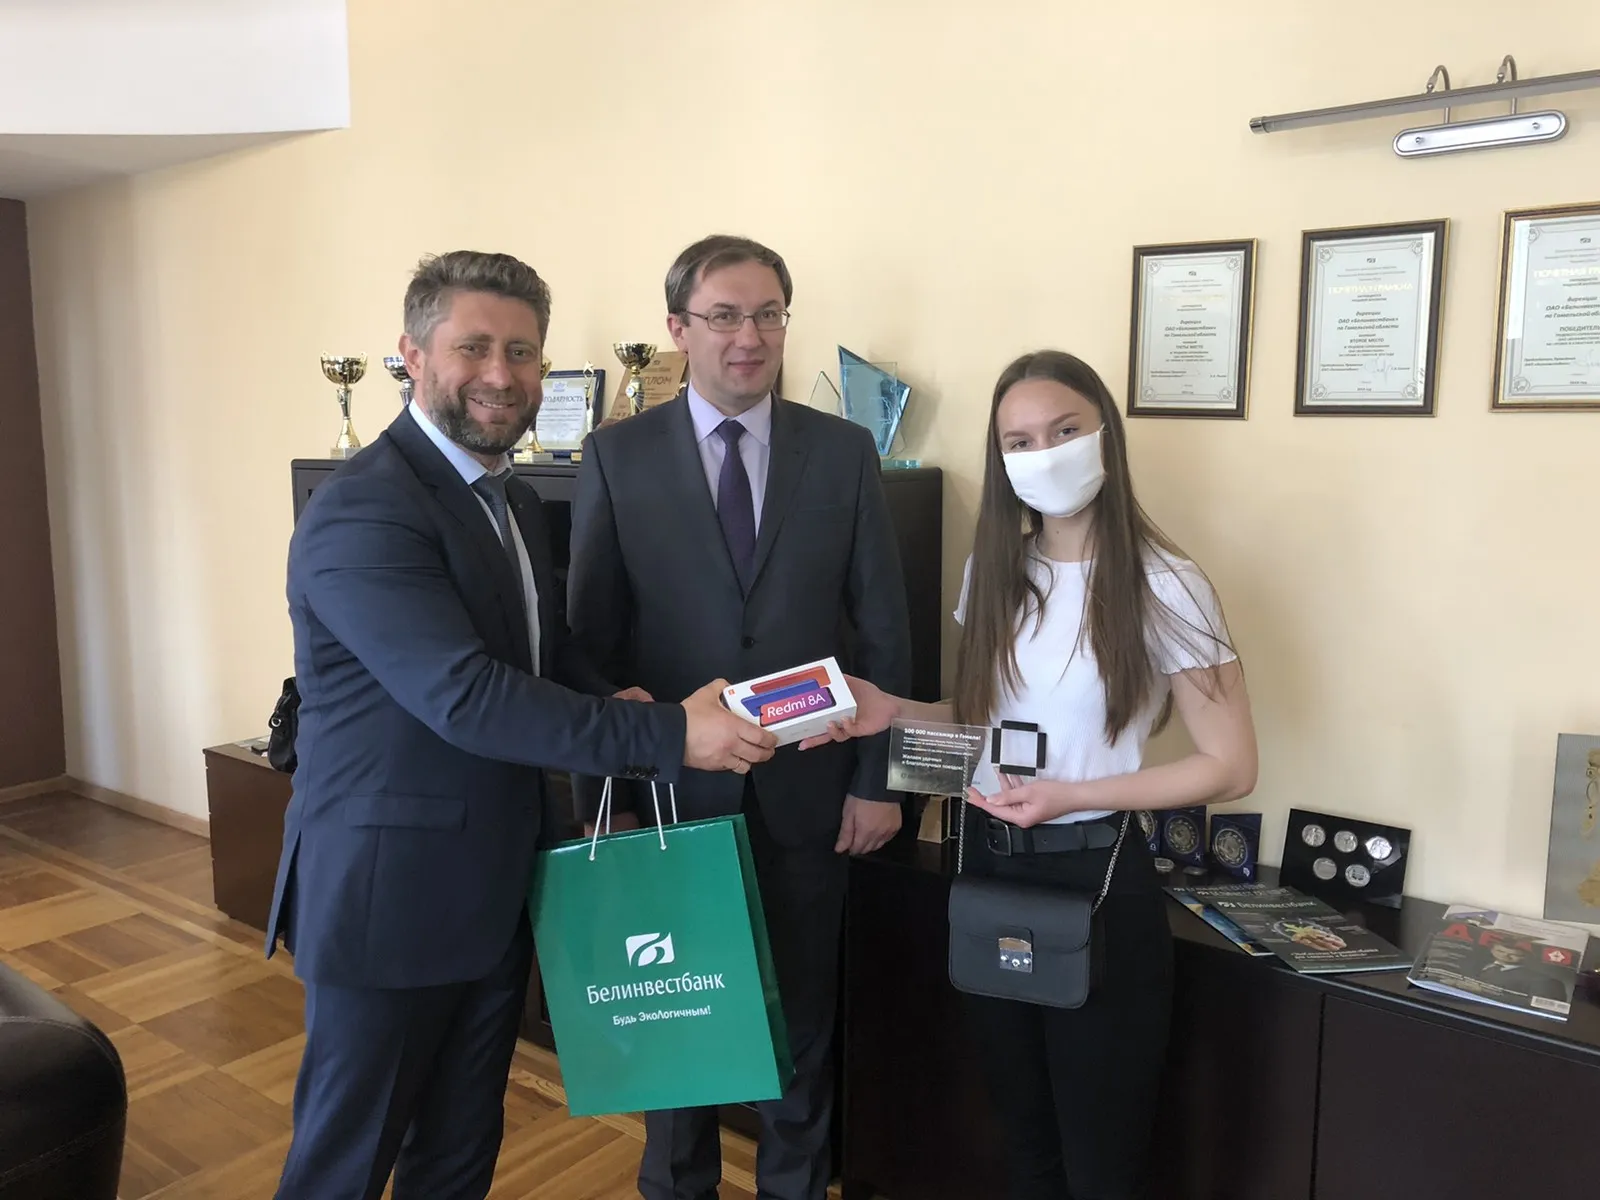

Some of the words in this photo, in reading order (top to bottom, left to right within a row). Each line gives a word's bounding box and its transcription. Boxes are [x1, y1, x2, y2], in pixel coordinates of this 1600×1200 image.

[767, 699, 807, 718] Redmi
[808, 693, 826, 706] 8A
[586, 972, 726, 1005] Белинвестбанк
[612, 1012, 637, 1027] Будь
